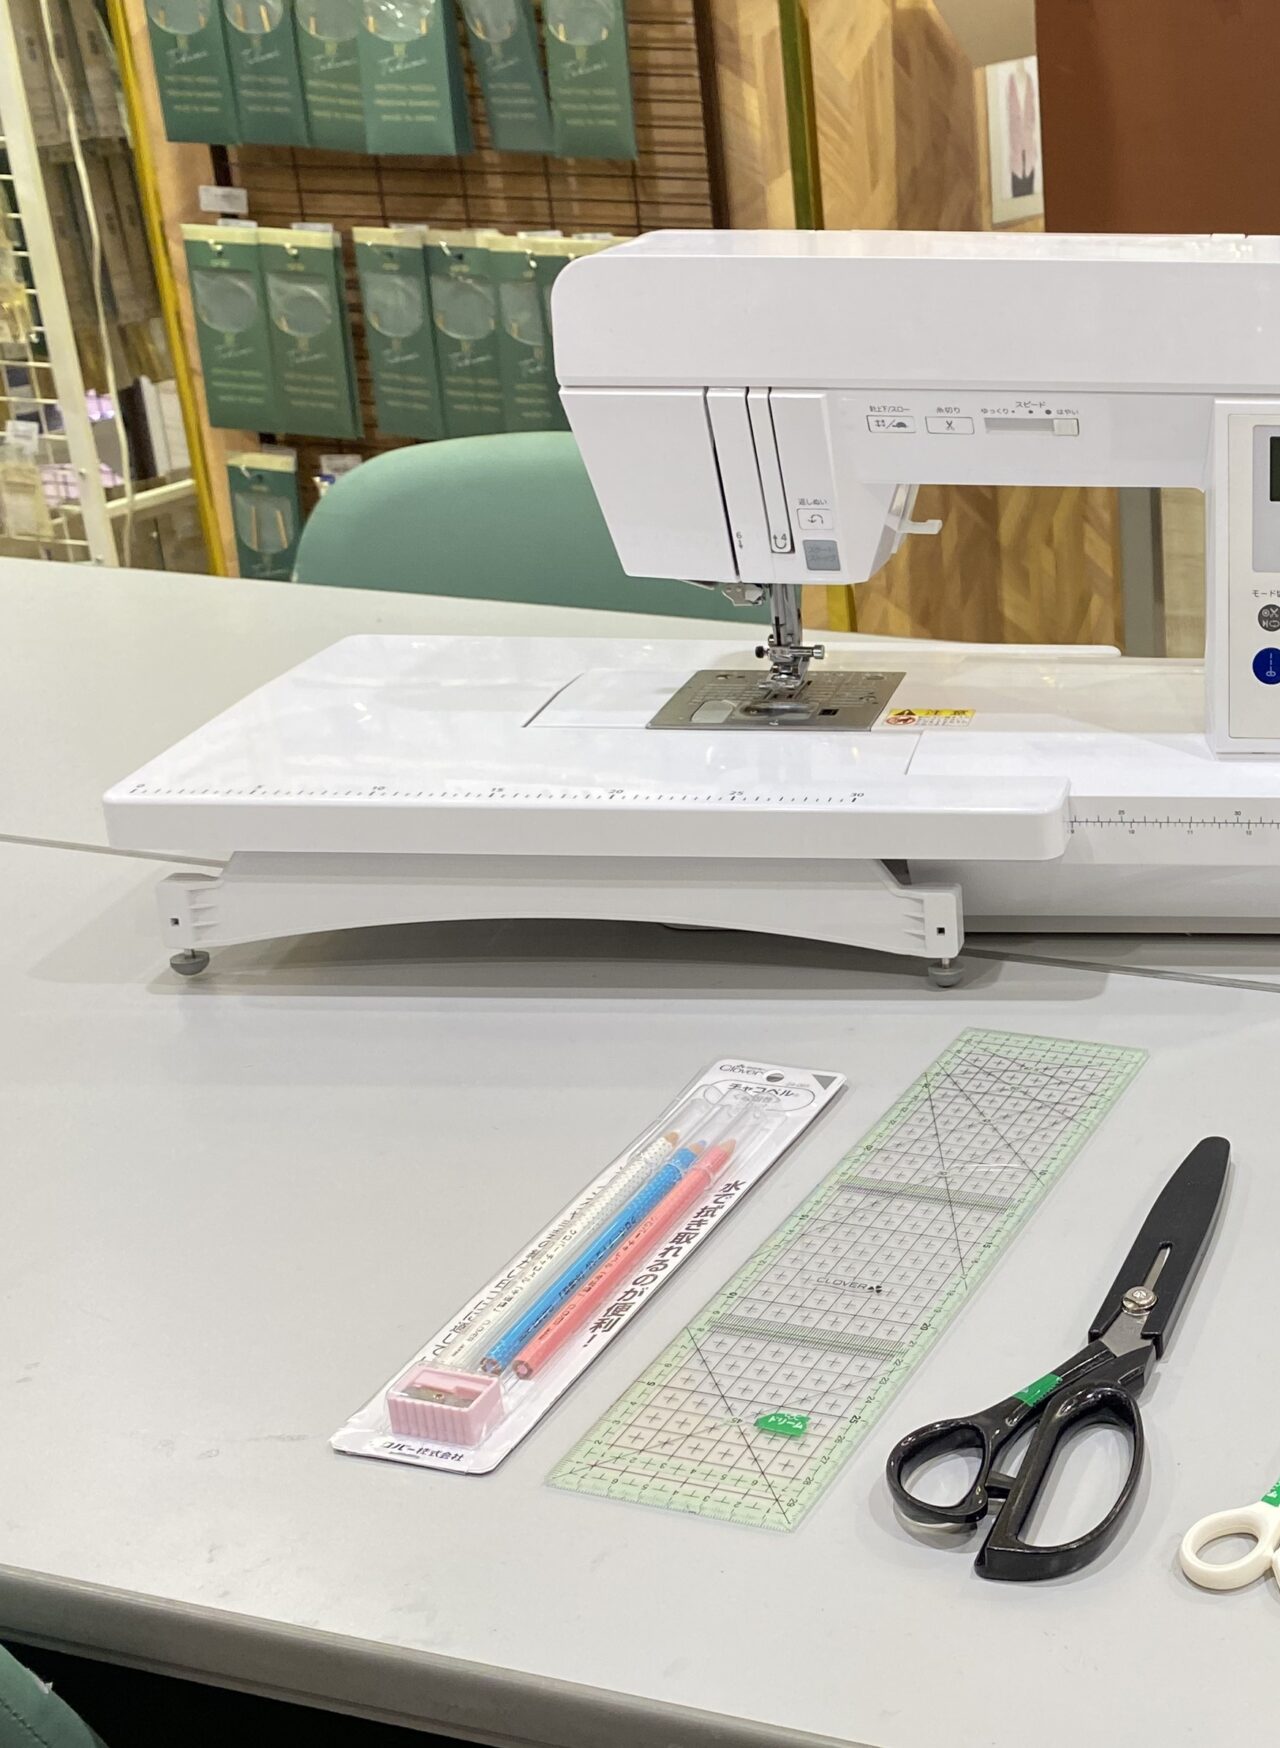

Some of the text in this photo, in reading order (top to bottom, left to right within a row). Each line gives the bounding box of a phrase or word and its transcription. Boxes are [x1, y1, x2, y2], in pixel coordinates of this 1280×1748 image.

[1015, 400, 1047, 409] スピード
[816, 1276, 869, 1290] CLOVER
[726, 1291, 738, 1300] 10
[865, 1395, 876, 1404] 24
[849, 1414, 862, 1424] 25
